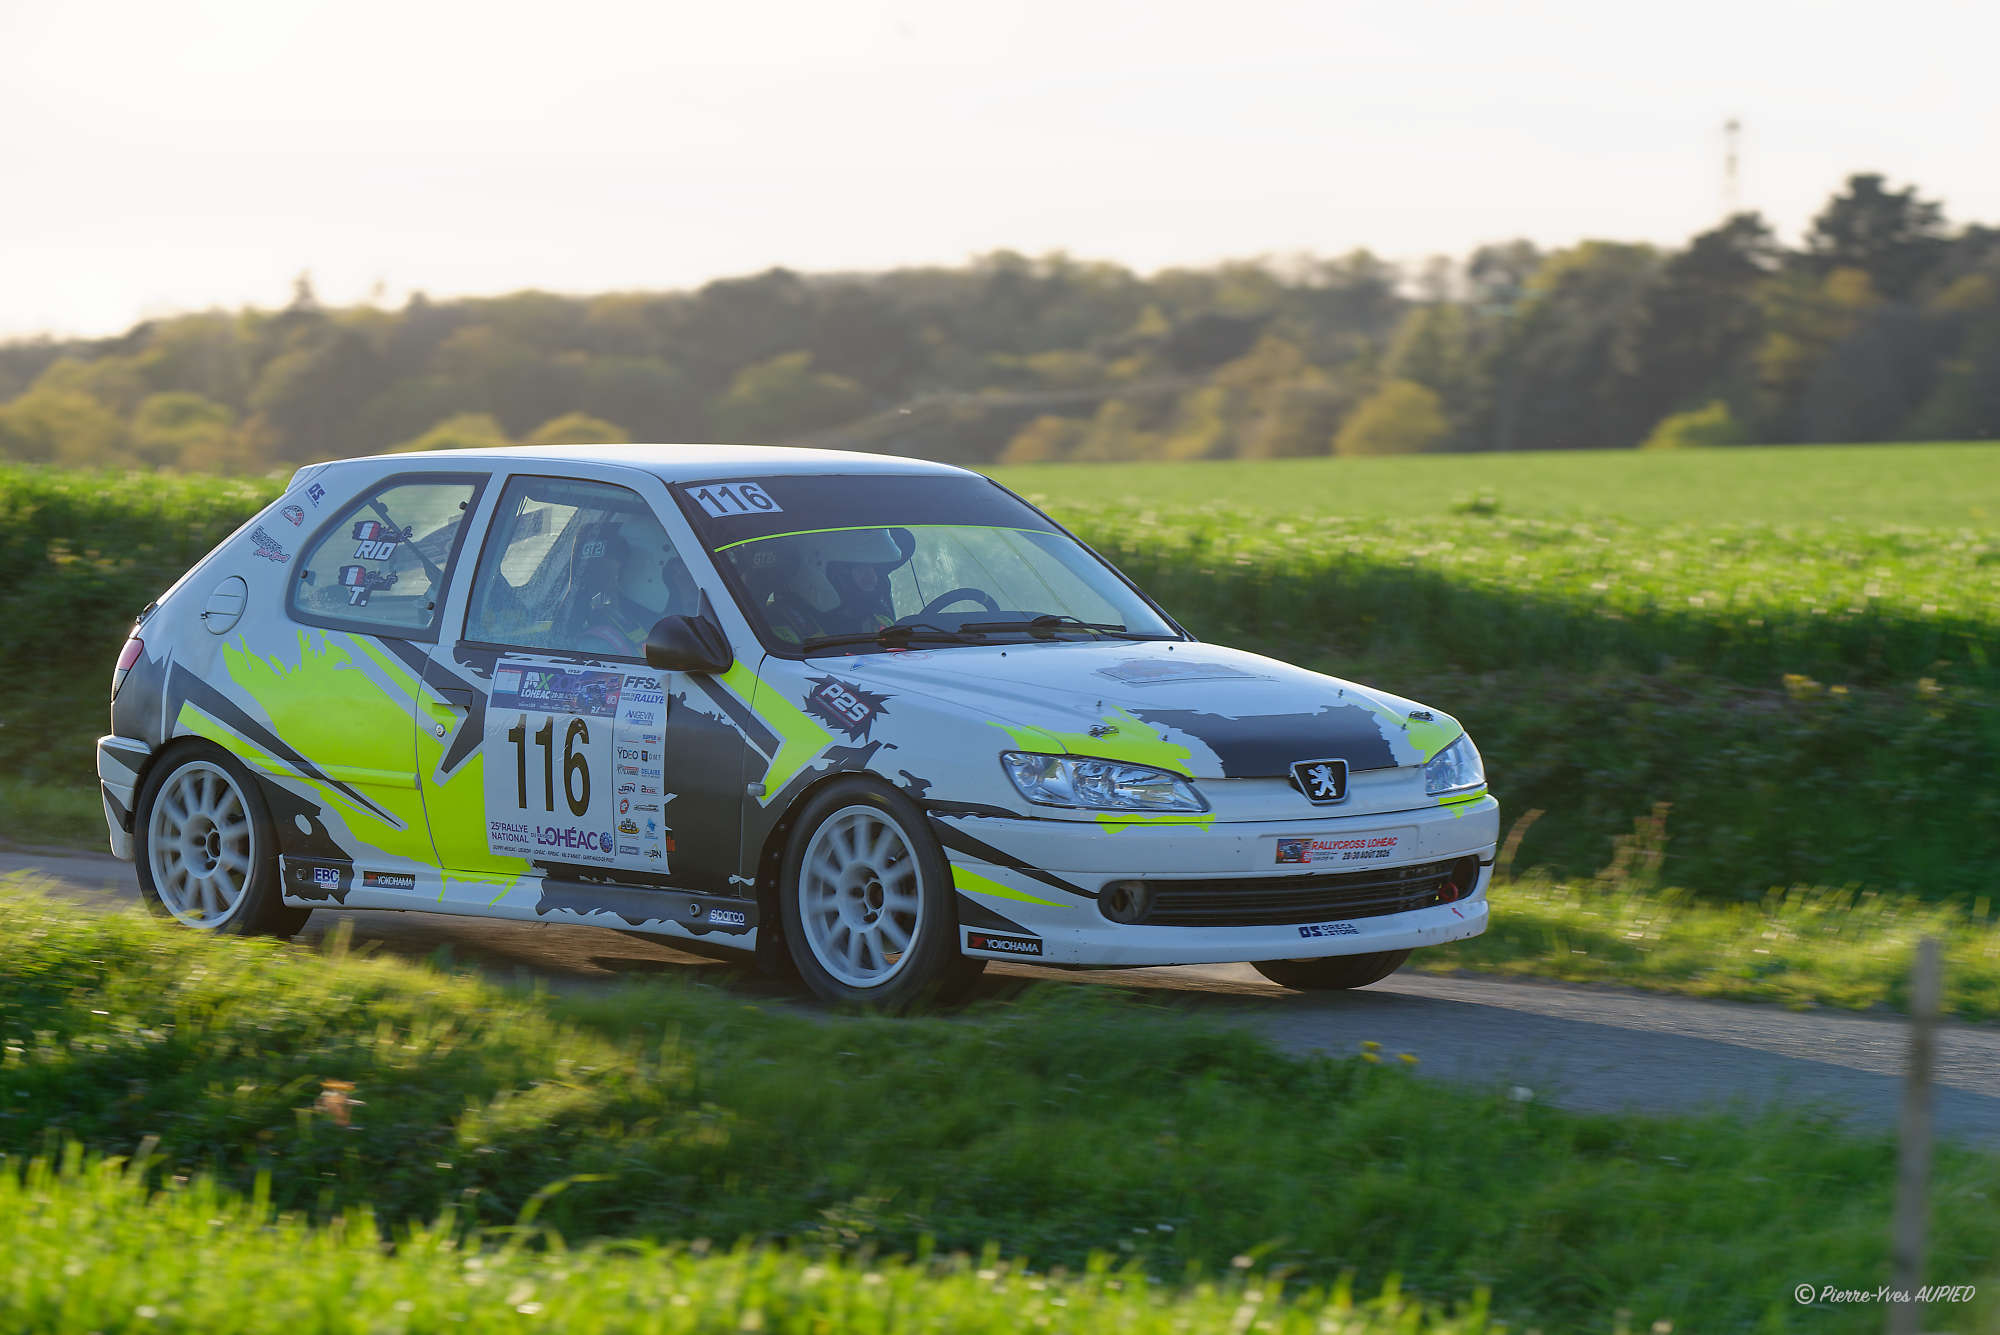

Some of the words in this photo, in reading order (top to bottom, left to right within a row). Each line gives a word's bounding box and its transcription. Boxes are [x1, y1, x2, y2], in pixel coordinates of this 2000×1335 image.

[697, 485, 773, 513] 116
[354, 540, 397, 560] RIO
[633, 693, 665, 704] RALLYE
[820, 683, 870, 722] P2S
[508, 713, 591, 817] 116
[502, 823, 528, 833] RALLYE
[491, 831, 529, 844] NATIONAL
[536, 825, 599, 851] LOHÉAC
[1312, 839, 1366, 851] RALLYCROSS
[314, 868, 339, 882] EBC
[376, 875, 413, 886] YOKOHAMA
[710, 909, 745, 923] sparco
[986, 938, 1040, 953] YOKOHAMA
